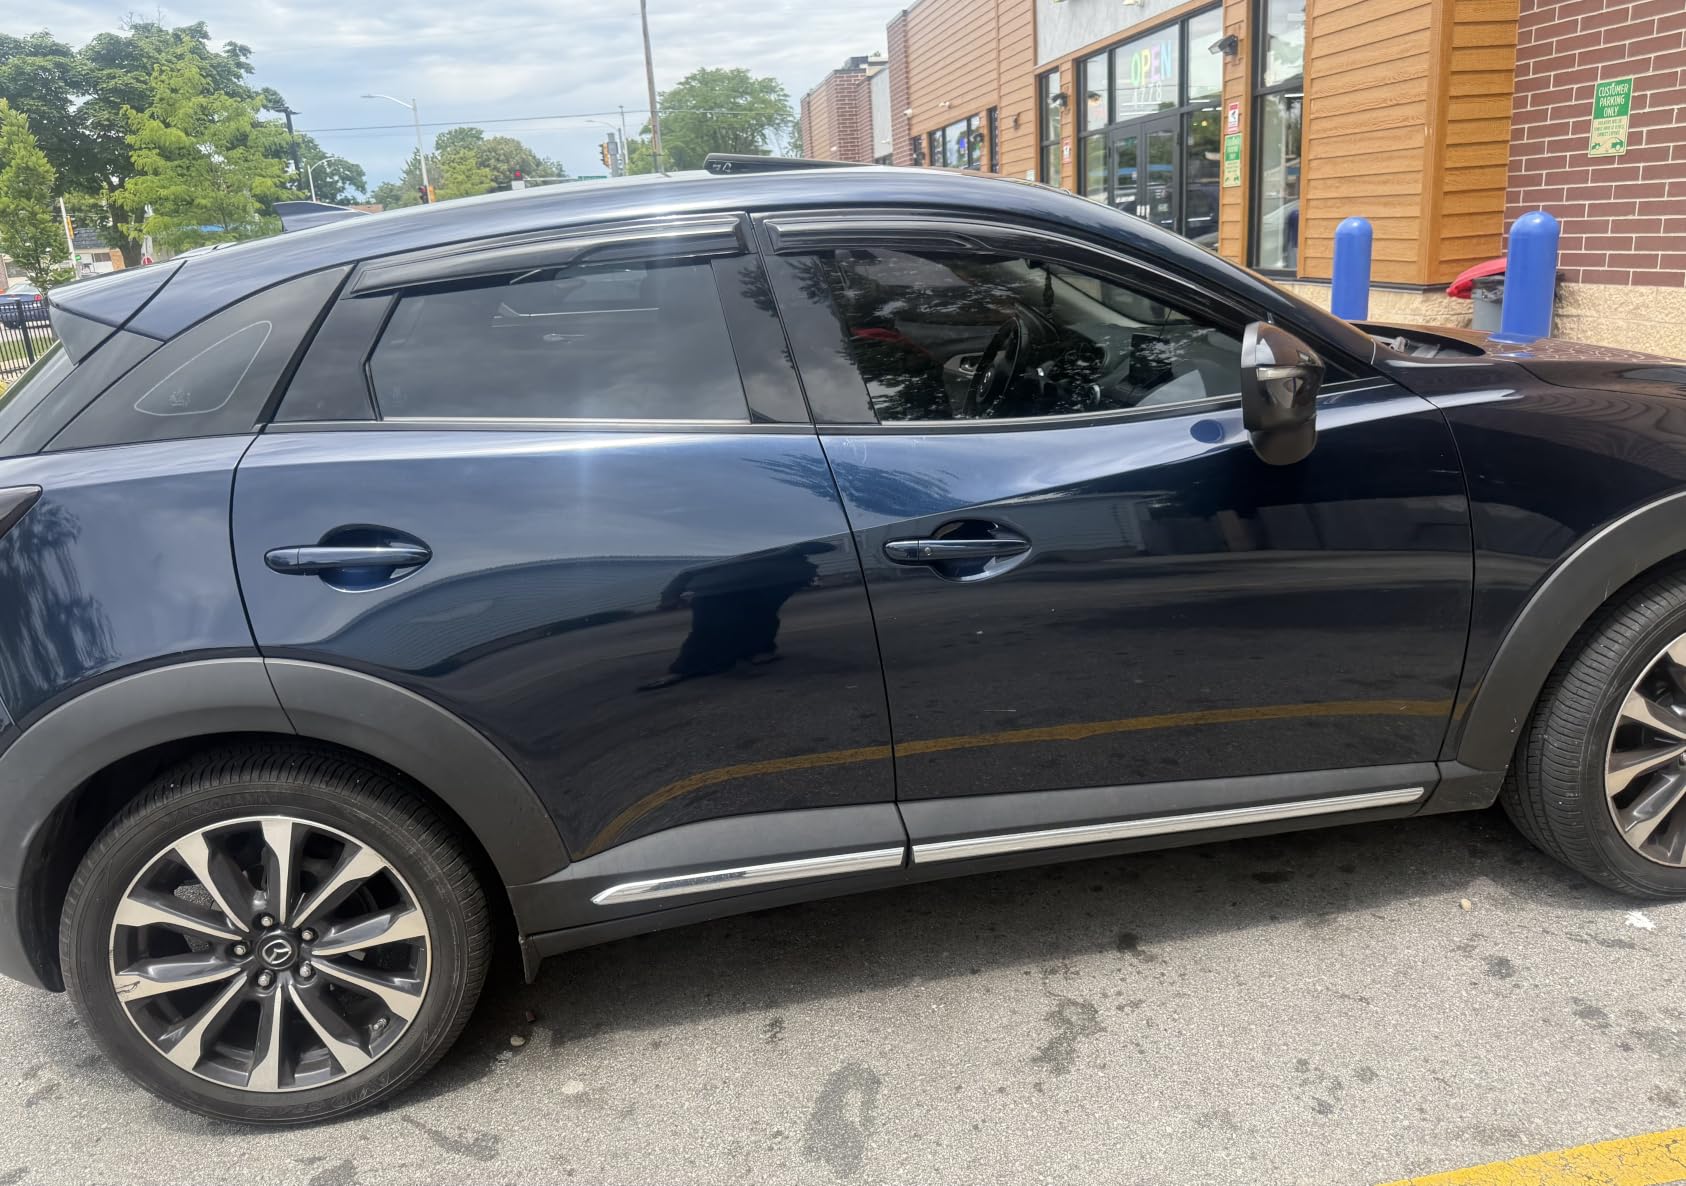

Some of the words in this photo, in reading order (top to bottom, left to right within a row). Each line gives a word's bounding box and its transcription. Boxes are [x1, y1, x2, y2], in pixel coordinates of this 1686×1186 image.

[1131, 41, 1172, 87] OPEN
[1598, 83, 1629, 97] CUSTOMER
[1600, 94, 1625, 107] PARKING
[1603, 106, 1619, 117] ONLY
